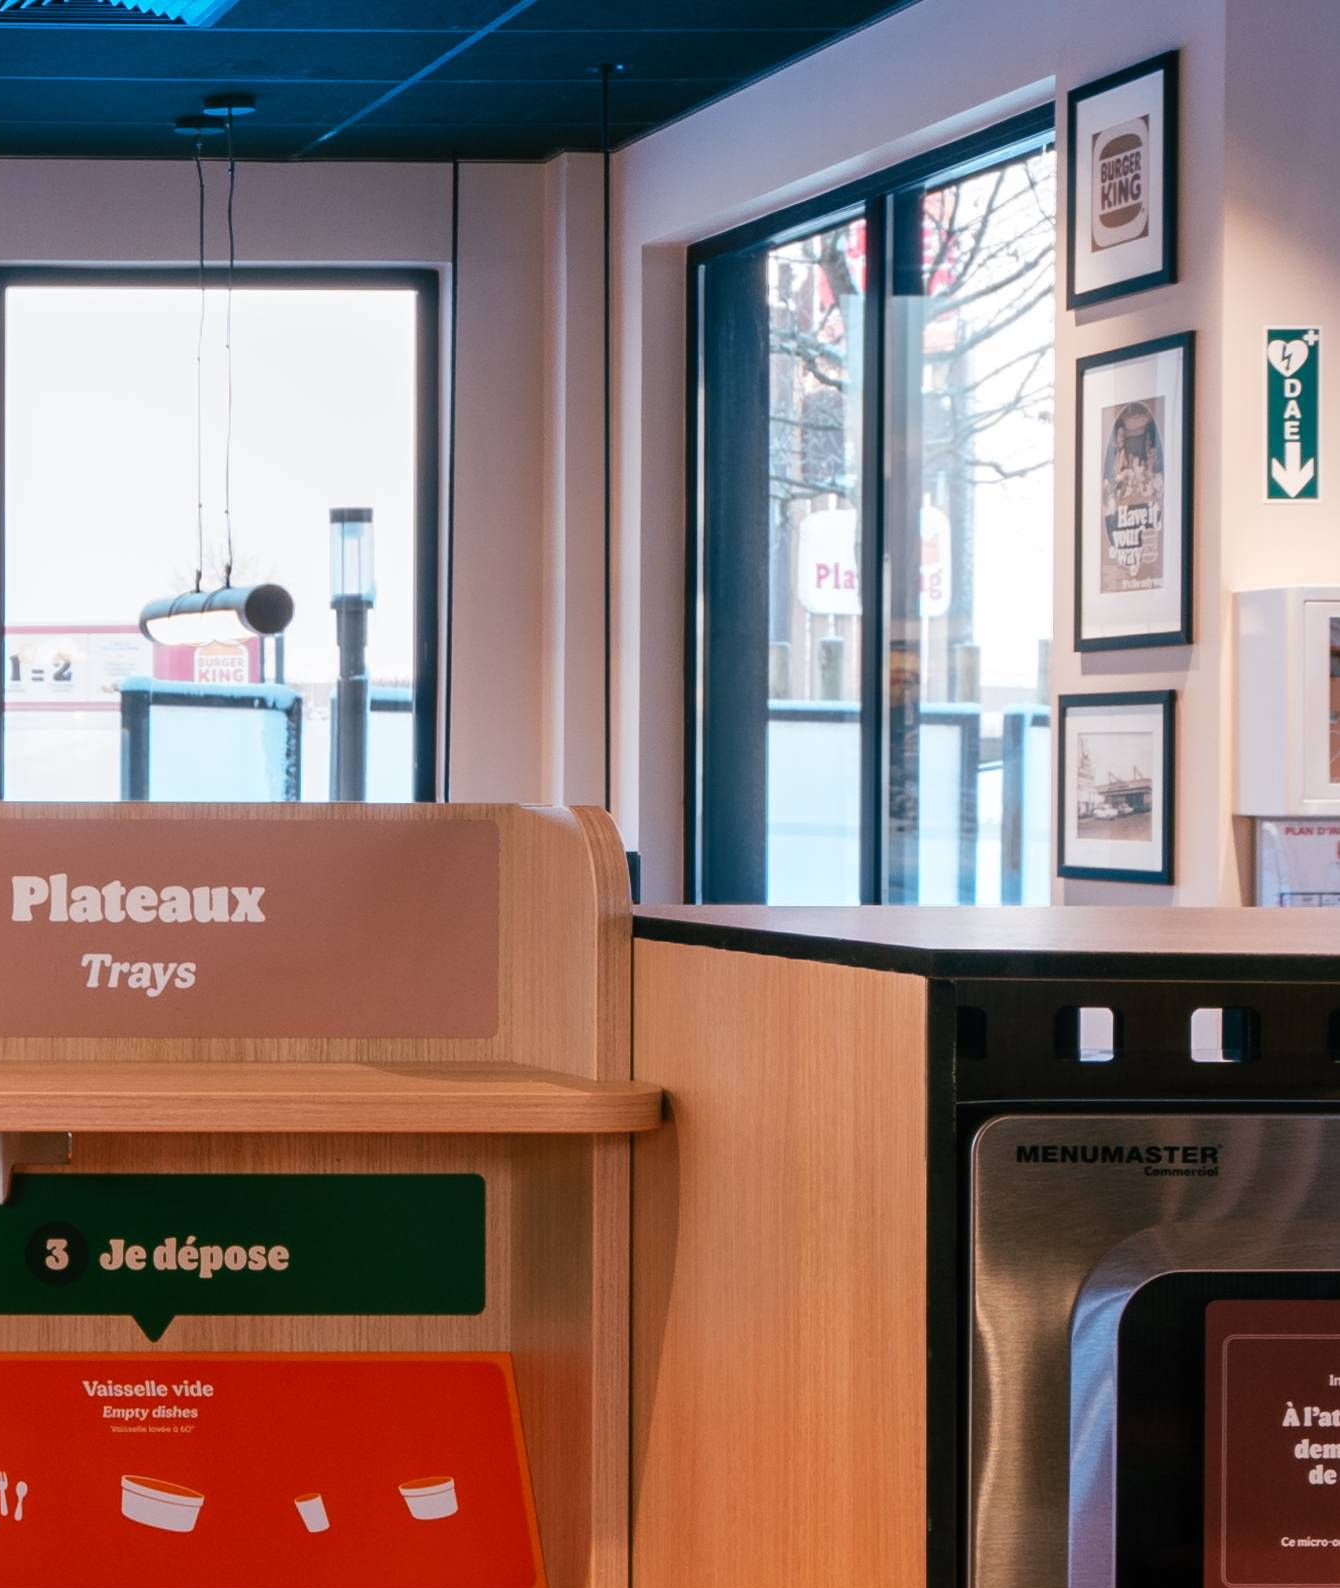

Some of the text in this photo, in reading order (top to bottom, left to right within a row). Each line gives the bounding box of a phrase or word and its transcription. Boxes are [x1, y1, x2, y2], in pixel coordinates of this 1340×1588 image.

[1101, 151, 1142, 184] BURGER
[1101, 173, 1142, 211] KING
[1284, 378, 1302, 440] DAE
[816, 562, 856, 590] Pla
[197, 656, 245, 668] BURGER
[198, 668, 244, 682] KING
[11, 873, 266, 923] Plateaux
[81, 953, 196, 998] Trays
[1016, 1145, 1219, 1163] MENUMASTER
[1144, 1166, 1219, 1177] Commercial
[45, 1235, 290, 1279] 3 Je dépose
[82, 1380, 214, 1397] Vaisselle vide
[102, 1405, 199, 1421] Empty dishes
[1282, 1401, 1301, 1427] À
[1308, 1464, 1337, 1485] de
[1281, 1536, 1296, 1548] Ce
